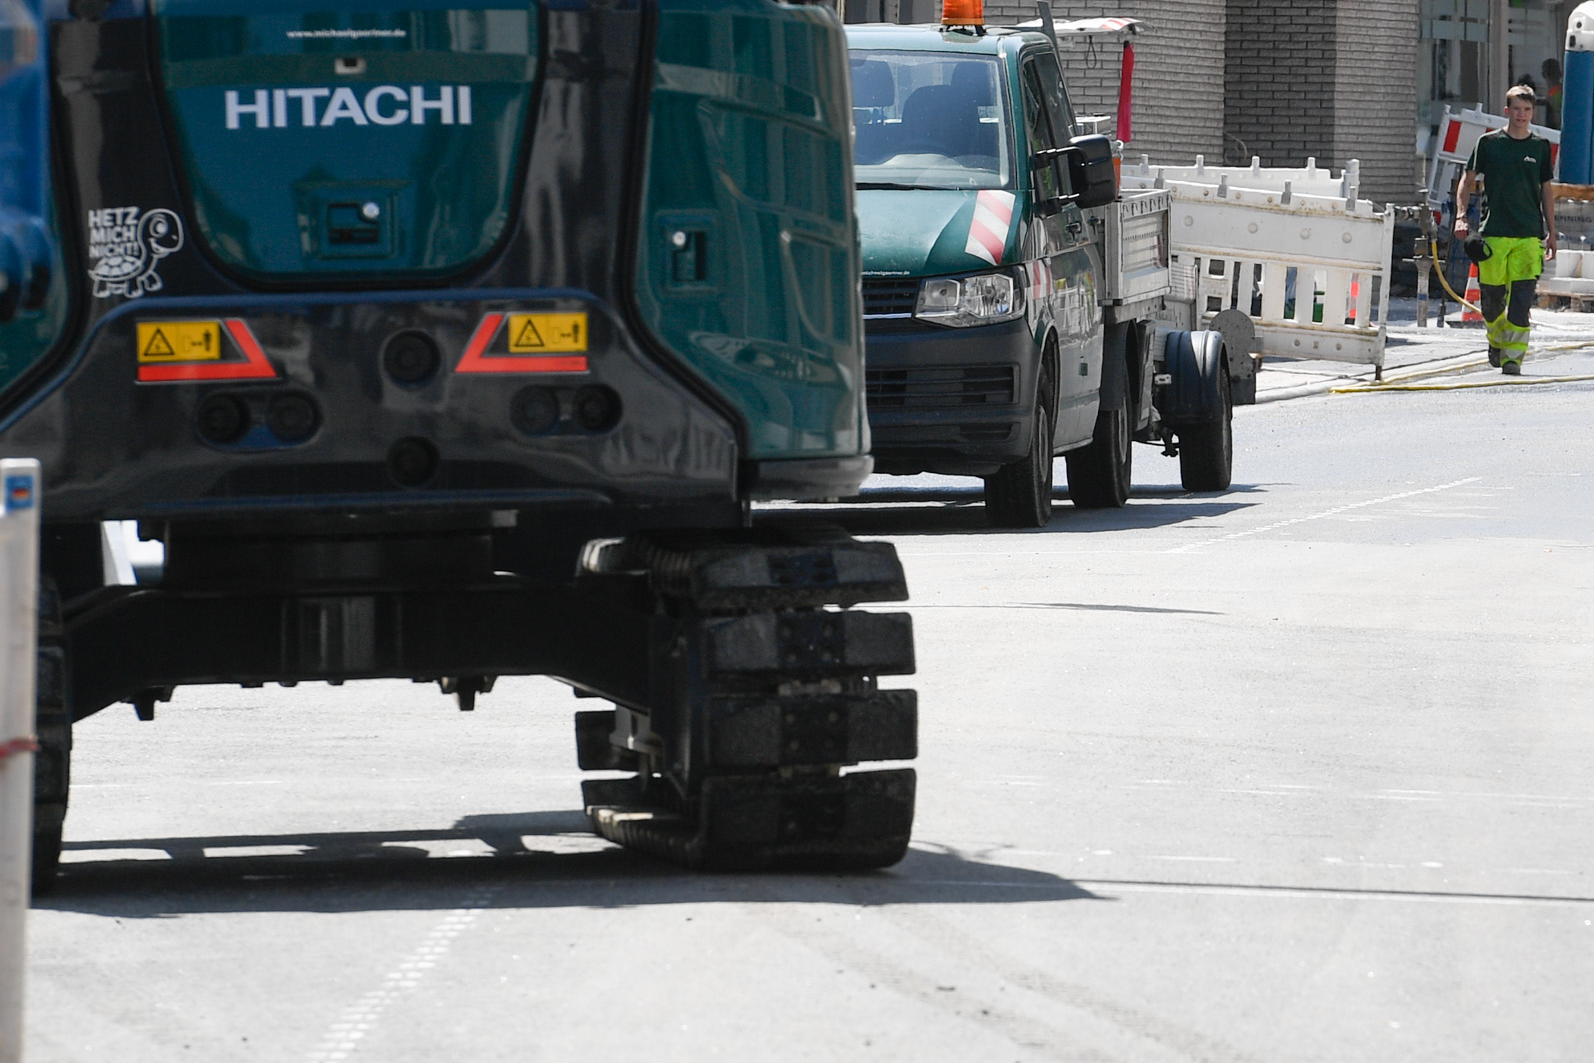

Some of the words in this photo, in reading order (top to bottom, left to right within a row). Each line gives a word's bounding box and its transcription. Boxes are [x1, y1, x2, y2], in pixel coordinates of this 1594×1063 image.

[225, 85, 473, 129] HITACHI
[88, 206, 139, 228] HETZ
[90, 225, 137, 244] MICH
[89, 241, 140, 259] NICHT!
